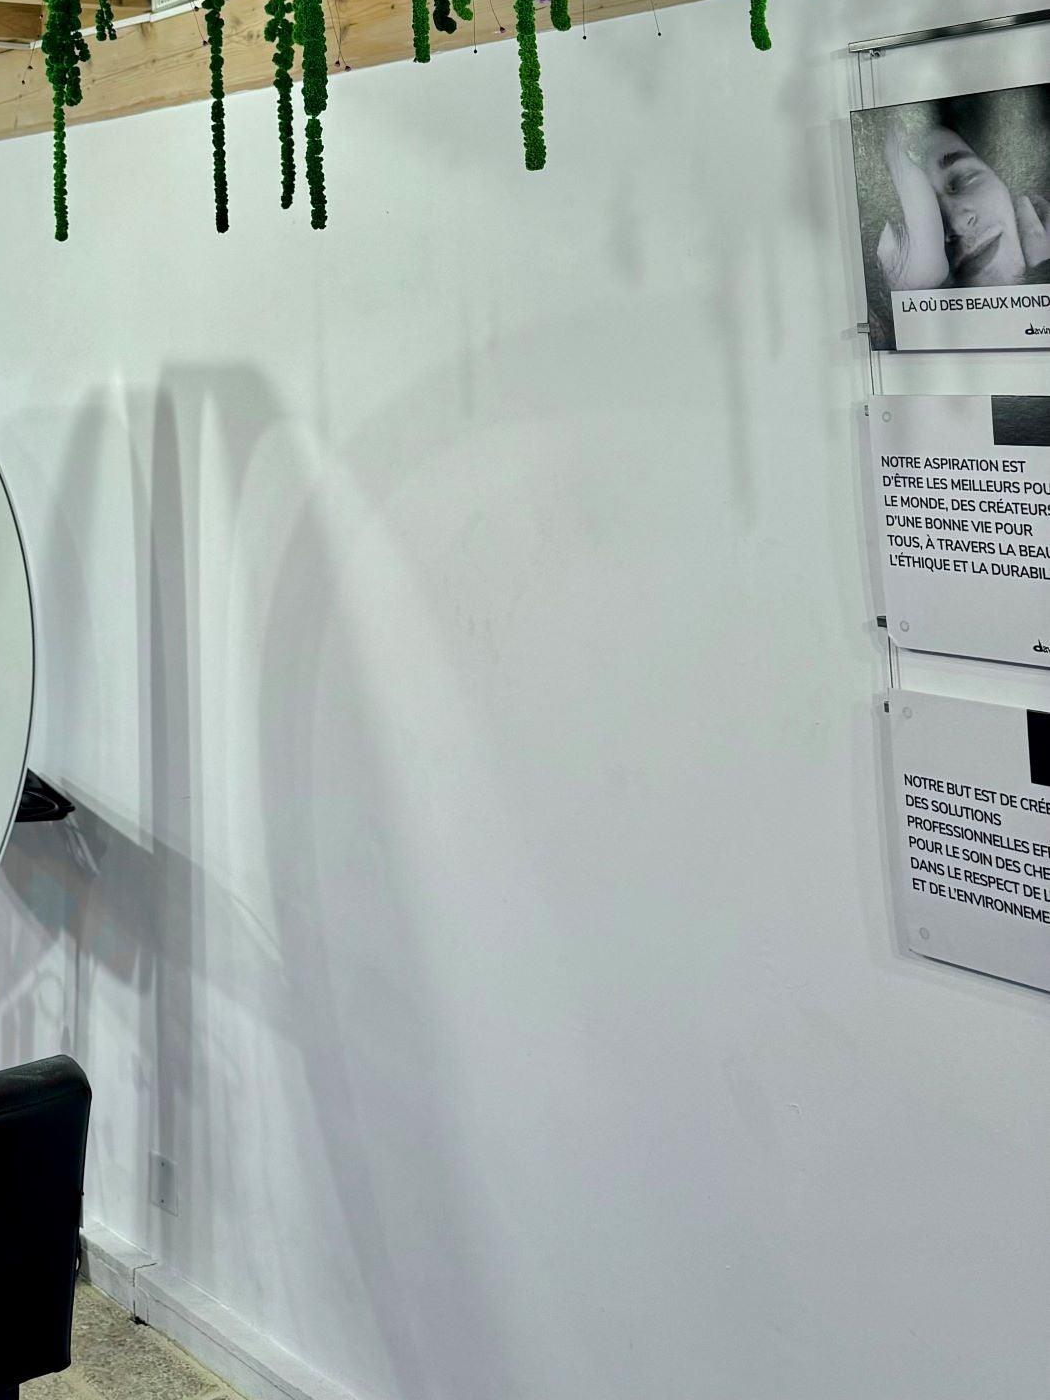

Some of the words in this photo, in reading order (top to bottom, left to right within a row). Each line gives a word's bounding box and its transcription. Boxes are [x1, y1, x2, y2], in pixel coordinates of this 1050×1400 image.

[902, 297, 918, 312] LÀ
[919, 297, 937, 312] OÙ
[940, 299, 964, 311] DES
[966, 297, 1009, 310] BEAUX
[1011, 295, 1050, 309] MOND
[881, 456, 921, 469] NOTRE
[924, 458, 999, 472] ASPIRATION
[1002, 460, 1026, 473] EST
[883, 473, 924, 489] D'ÊTRE
[927, 478, 948, 490] LES
[951, 479, 1021, 494] MEILLEURS
[1024, 482, 1050, 495] POU
[884, 495, 899, 507] LE
[901, 496, 949, 512] MONDE,
[951, 499, 976, 512] DES
[886, 515, 923, 529] D'UNE
[925, 518, 969, 532] BONNE
[971, 521, 992, 533] VIE
[995, 522, 1033, 537] POUR
[887, 535, 923, 551] TOUS,
[926, 535, 935, 550] À
[937, 539, 996, 554] TRAVERS
[999, 543, 1016, 557] LA
[890, 552, 951, 572] L'ÉTHIQUE
[953, 560, 968, 573] ET
[972, 561, 989, 575] LA
[991, 563, 1050, 580] DURABIL
[1033, 639, 1050, 654] da
[904, 774, 945, 793] NOTRE
[947, 782, 971, 799] BUT
[974, 788, 997, 804] EST
[1000, 793, 1018, 809] DE
[906, 795, 929, 811] DES
[932, 801, 1002, 826] SOLUTIONS
[907, 815, 1030, 854] PROFESSIONNELLES
[909, 836, 943, 855] POUR
[946, 845, 960, 859] LE
[962, 849, 993, 867] SOIN
[995, 856, 1021, 874] DES
[1024, 863, 1050, 881] CHE
[911, 857, 945, 876] DANS
[948, 866, 962, 881] LE
[964, 870, 1020, 895] RESPECT
[1023, 884, 1041, 901] DE
[912, 878, 927, 892] ET
[929, 882, 947, 898] DE
[948, 887, 1050, 925] L'ENVIRONNEME
